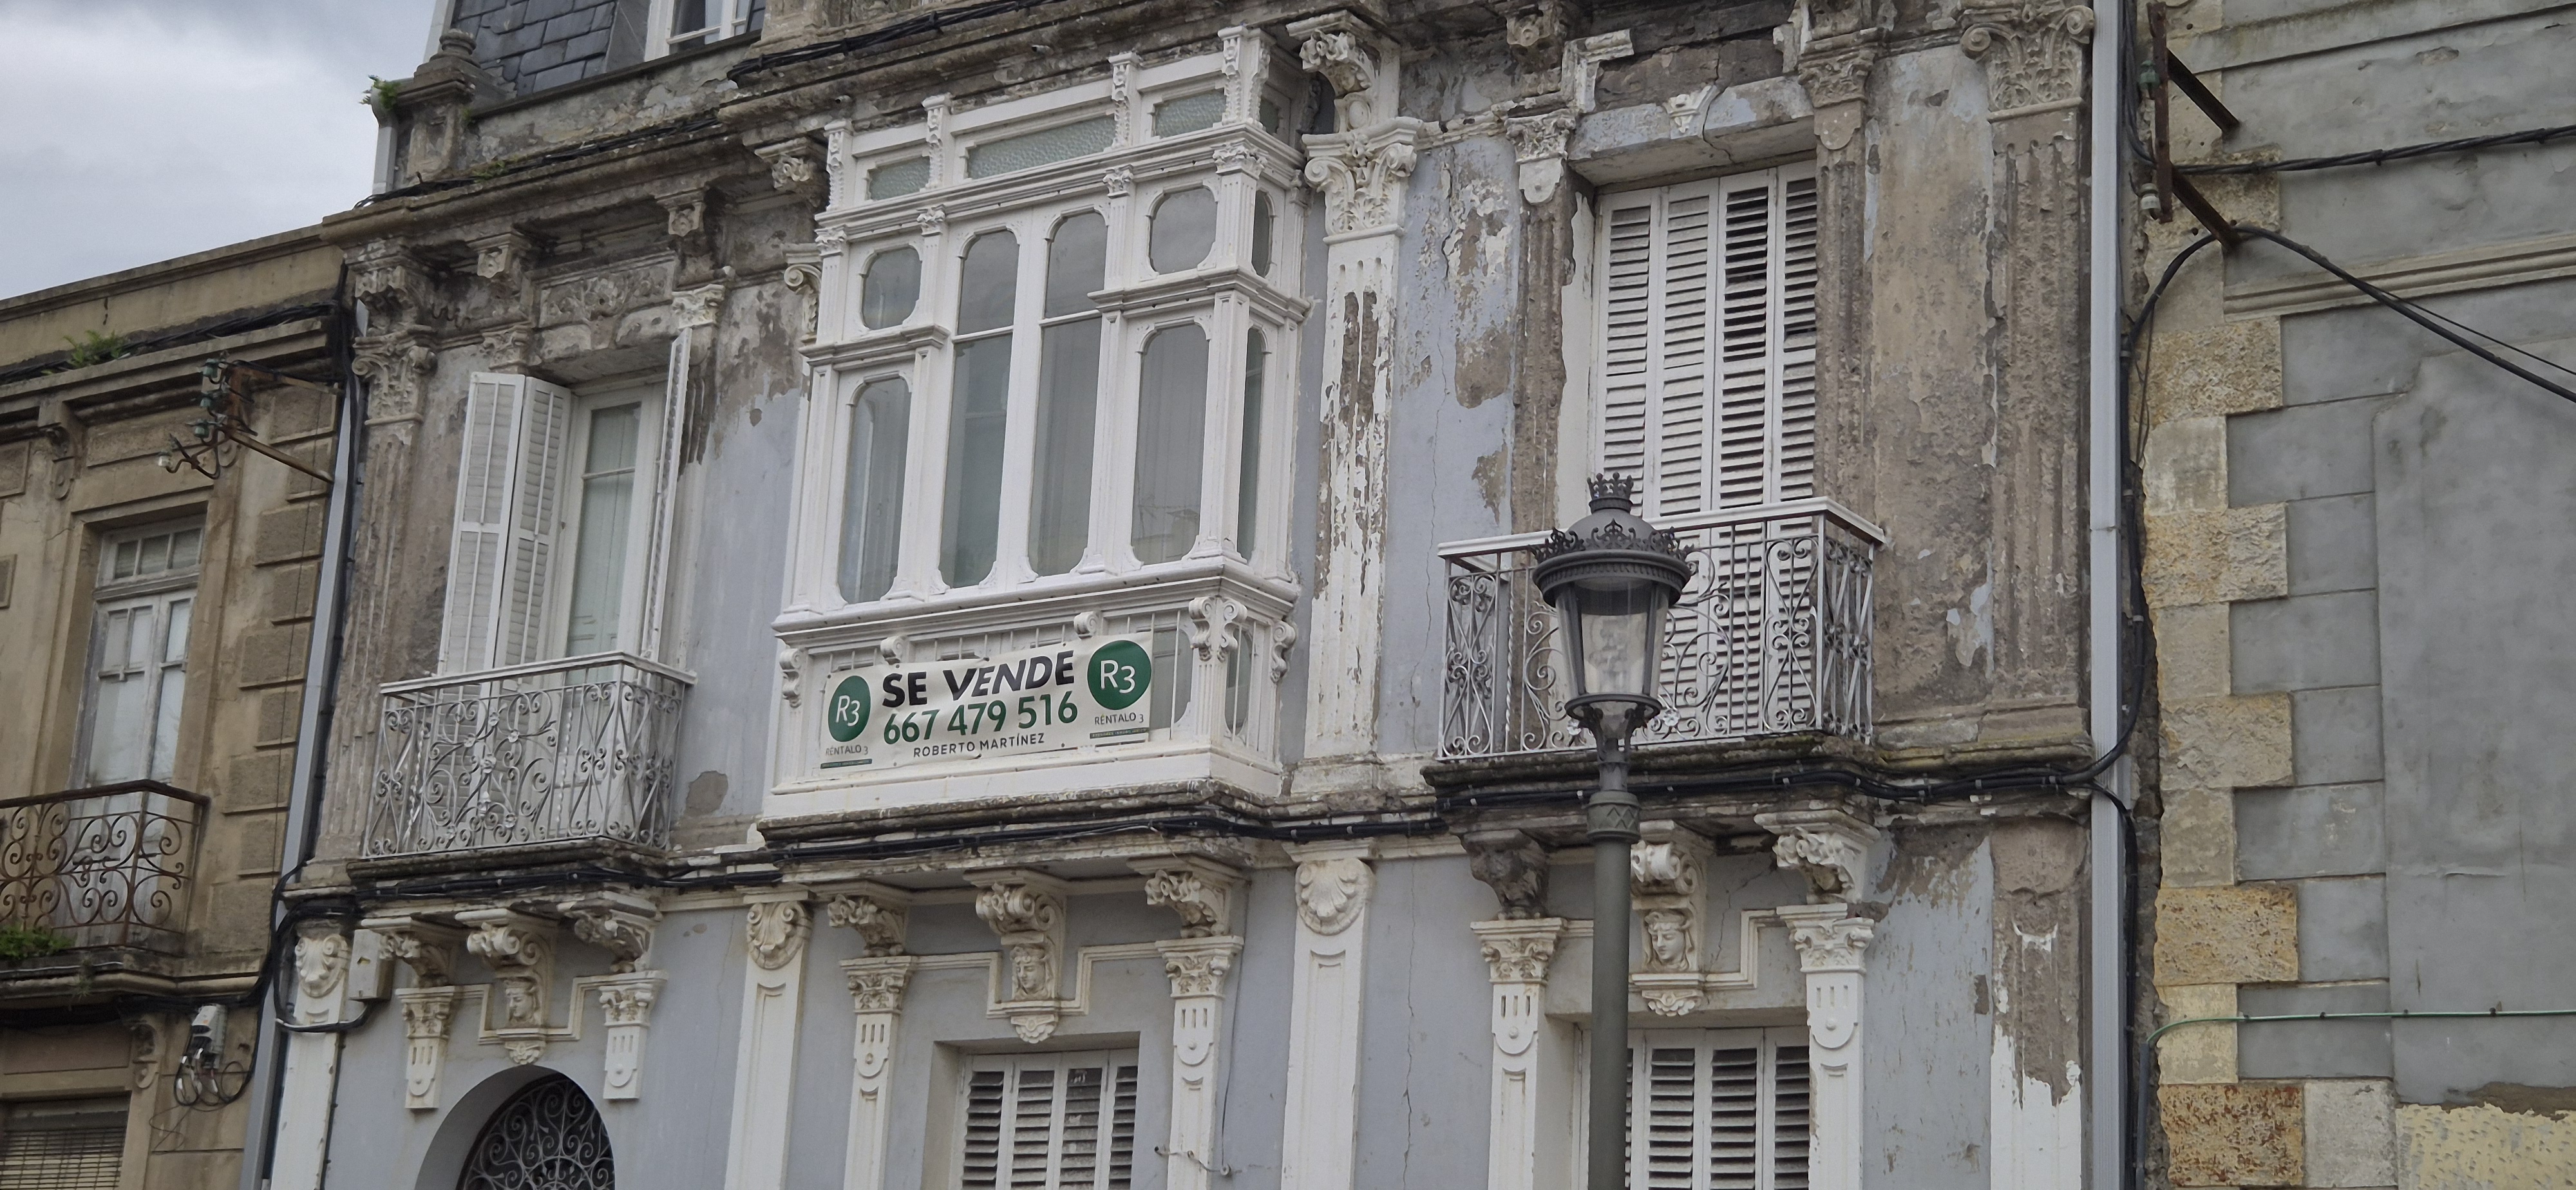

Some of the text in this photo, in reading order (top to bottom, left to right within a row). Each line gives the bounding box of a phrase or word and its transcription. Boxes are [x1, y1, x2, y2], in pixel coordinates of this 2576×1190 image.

[882, 650, 1074, 708] SE VENDE
[1101, 659, 1135, 694] R3
[836, 695, 860, 726] R3
[884, 690, 1078, 744] 667 479 516
[1139, 713, 1144, 723] 3
[864, 746, 869, 755] 3
[913, 733, 1045, 758] ROBERTO MARTÍNEZ
